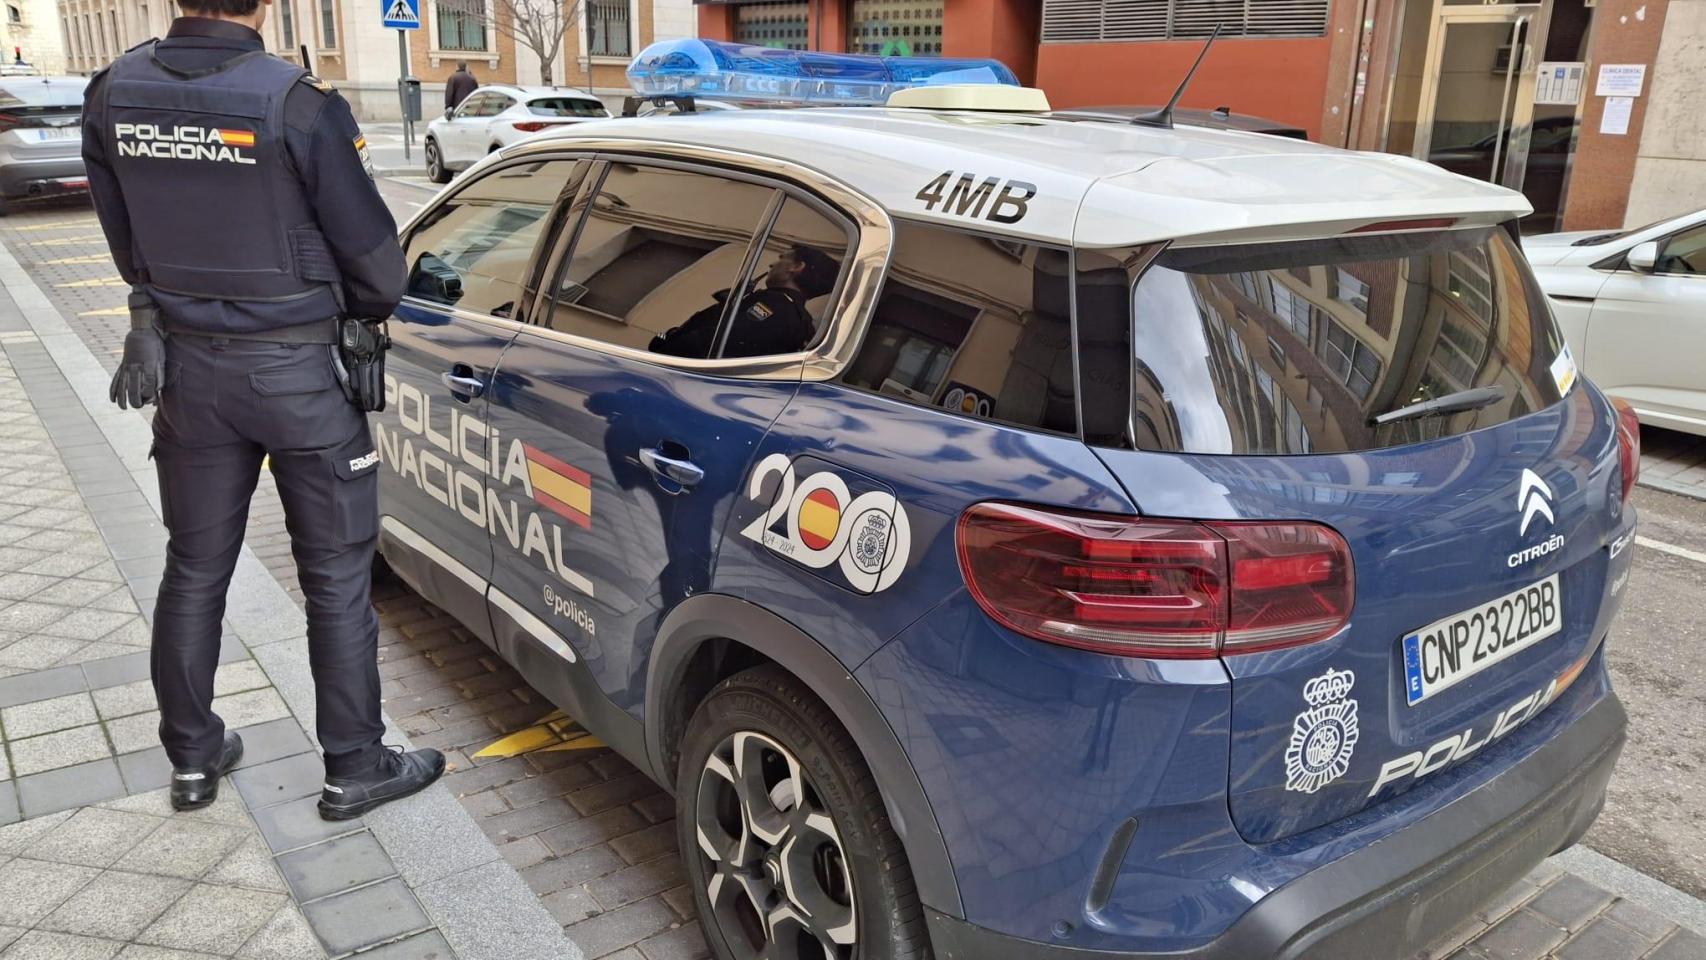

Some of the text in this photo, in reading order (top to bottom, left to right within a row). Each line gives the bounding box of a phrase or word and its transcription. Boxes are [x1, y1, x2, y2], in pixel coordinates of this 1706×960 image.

[115, 123, 225, 144] POLICIA
[117, 141, 256, 164] NACIONAL
[916, 170, 1037, 224] 4MB
[377, 422, 594, 597] NACIONAL
[740, 453, 911, 593] 200
[543, 584, 595, 636] @policia
[1421, 581, 1556, 685] CNP2322BB
[1411, 676, 1419, 691] E
[1313, 720, 1338, 732] POLICIA
[1367, 679, 1557, 798] POLICIA
